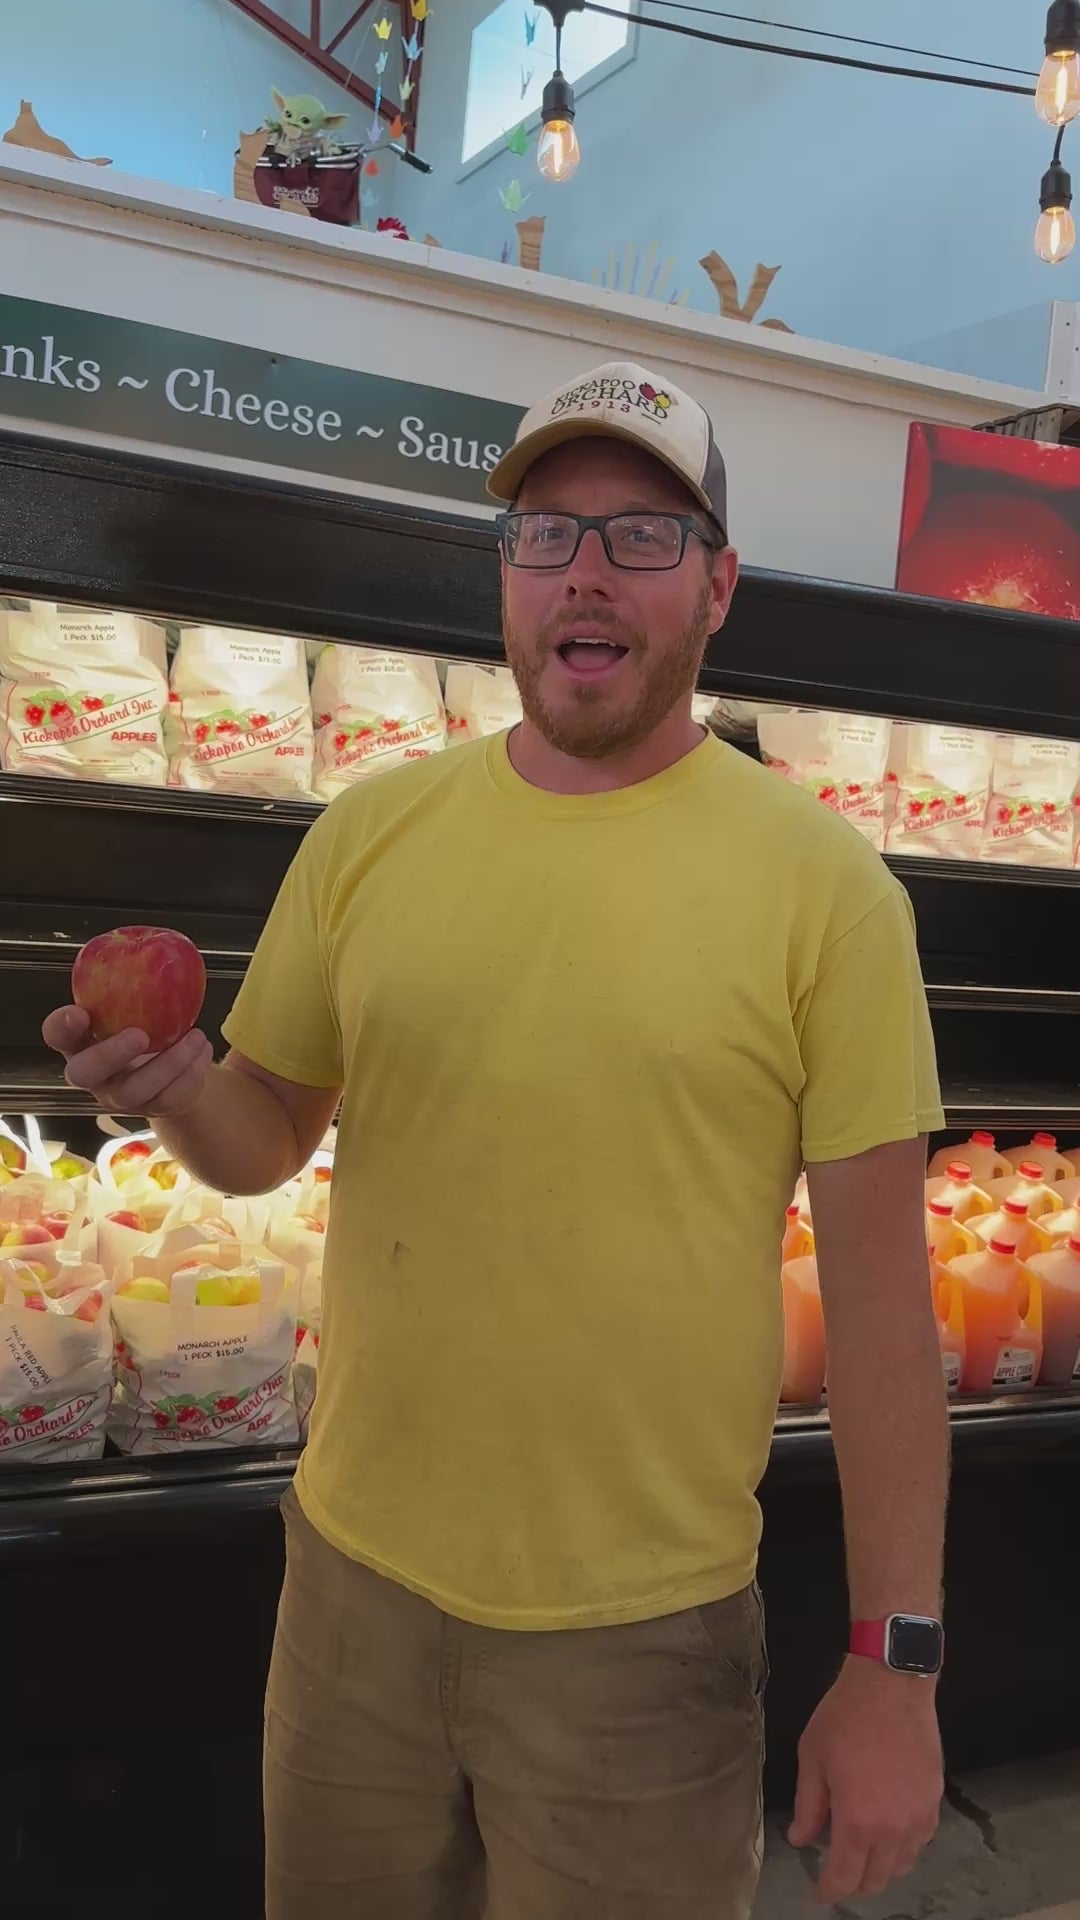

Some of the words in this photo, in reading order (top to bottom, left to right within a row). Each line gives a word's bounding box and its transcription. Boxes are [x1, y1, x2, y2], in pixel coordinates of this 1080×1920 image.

[0, 336, 101, 392] nks
[164, 367, 343, 441] Cheese
[398, 416, 502, 473] Saus
[551, 386, 669, 419] ORCHARD
[555, 378, 636, 406] KICKAPOO
[576, 400, 631, 413] 1913
[60, 624, 93, 632] Monarch
[94, 624, 115, 632] Apple
[70, 633, 88, 641] Peck
[22, 725, 81, 744] Kickapoo
[80, 703, 131, 733] Orchard
[133, 698, 158, 715] Inc.
[111, 731, 158, 743] APPLES
[377, 724, 423, 751] Orchard
[24, 1349, 37, 1365] RED
[177, 1340, 220, 1352] MONARCH
[222, 1335, 248, 1346] APPLE
[191, 1352, 213, 1360] PECK
[216, 1346, 244, 1358] $15.00
[8, 1342, 22, 1362] PECK
[20, 1363, 40, 1387] $15.00
[14, 1403, 75, 1441] Orchard
[212, 1393, 263, 1430] Orchard
